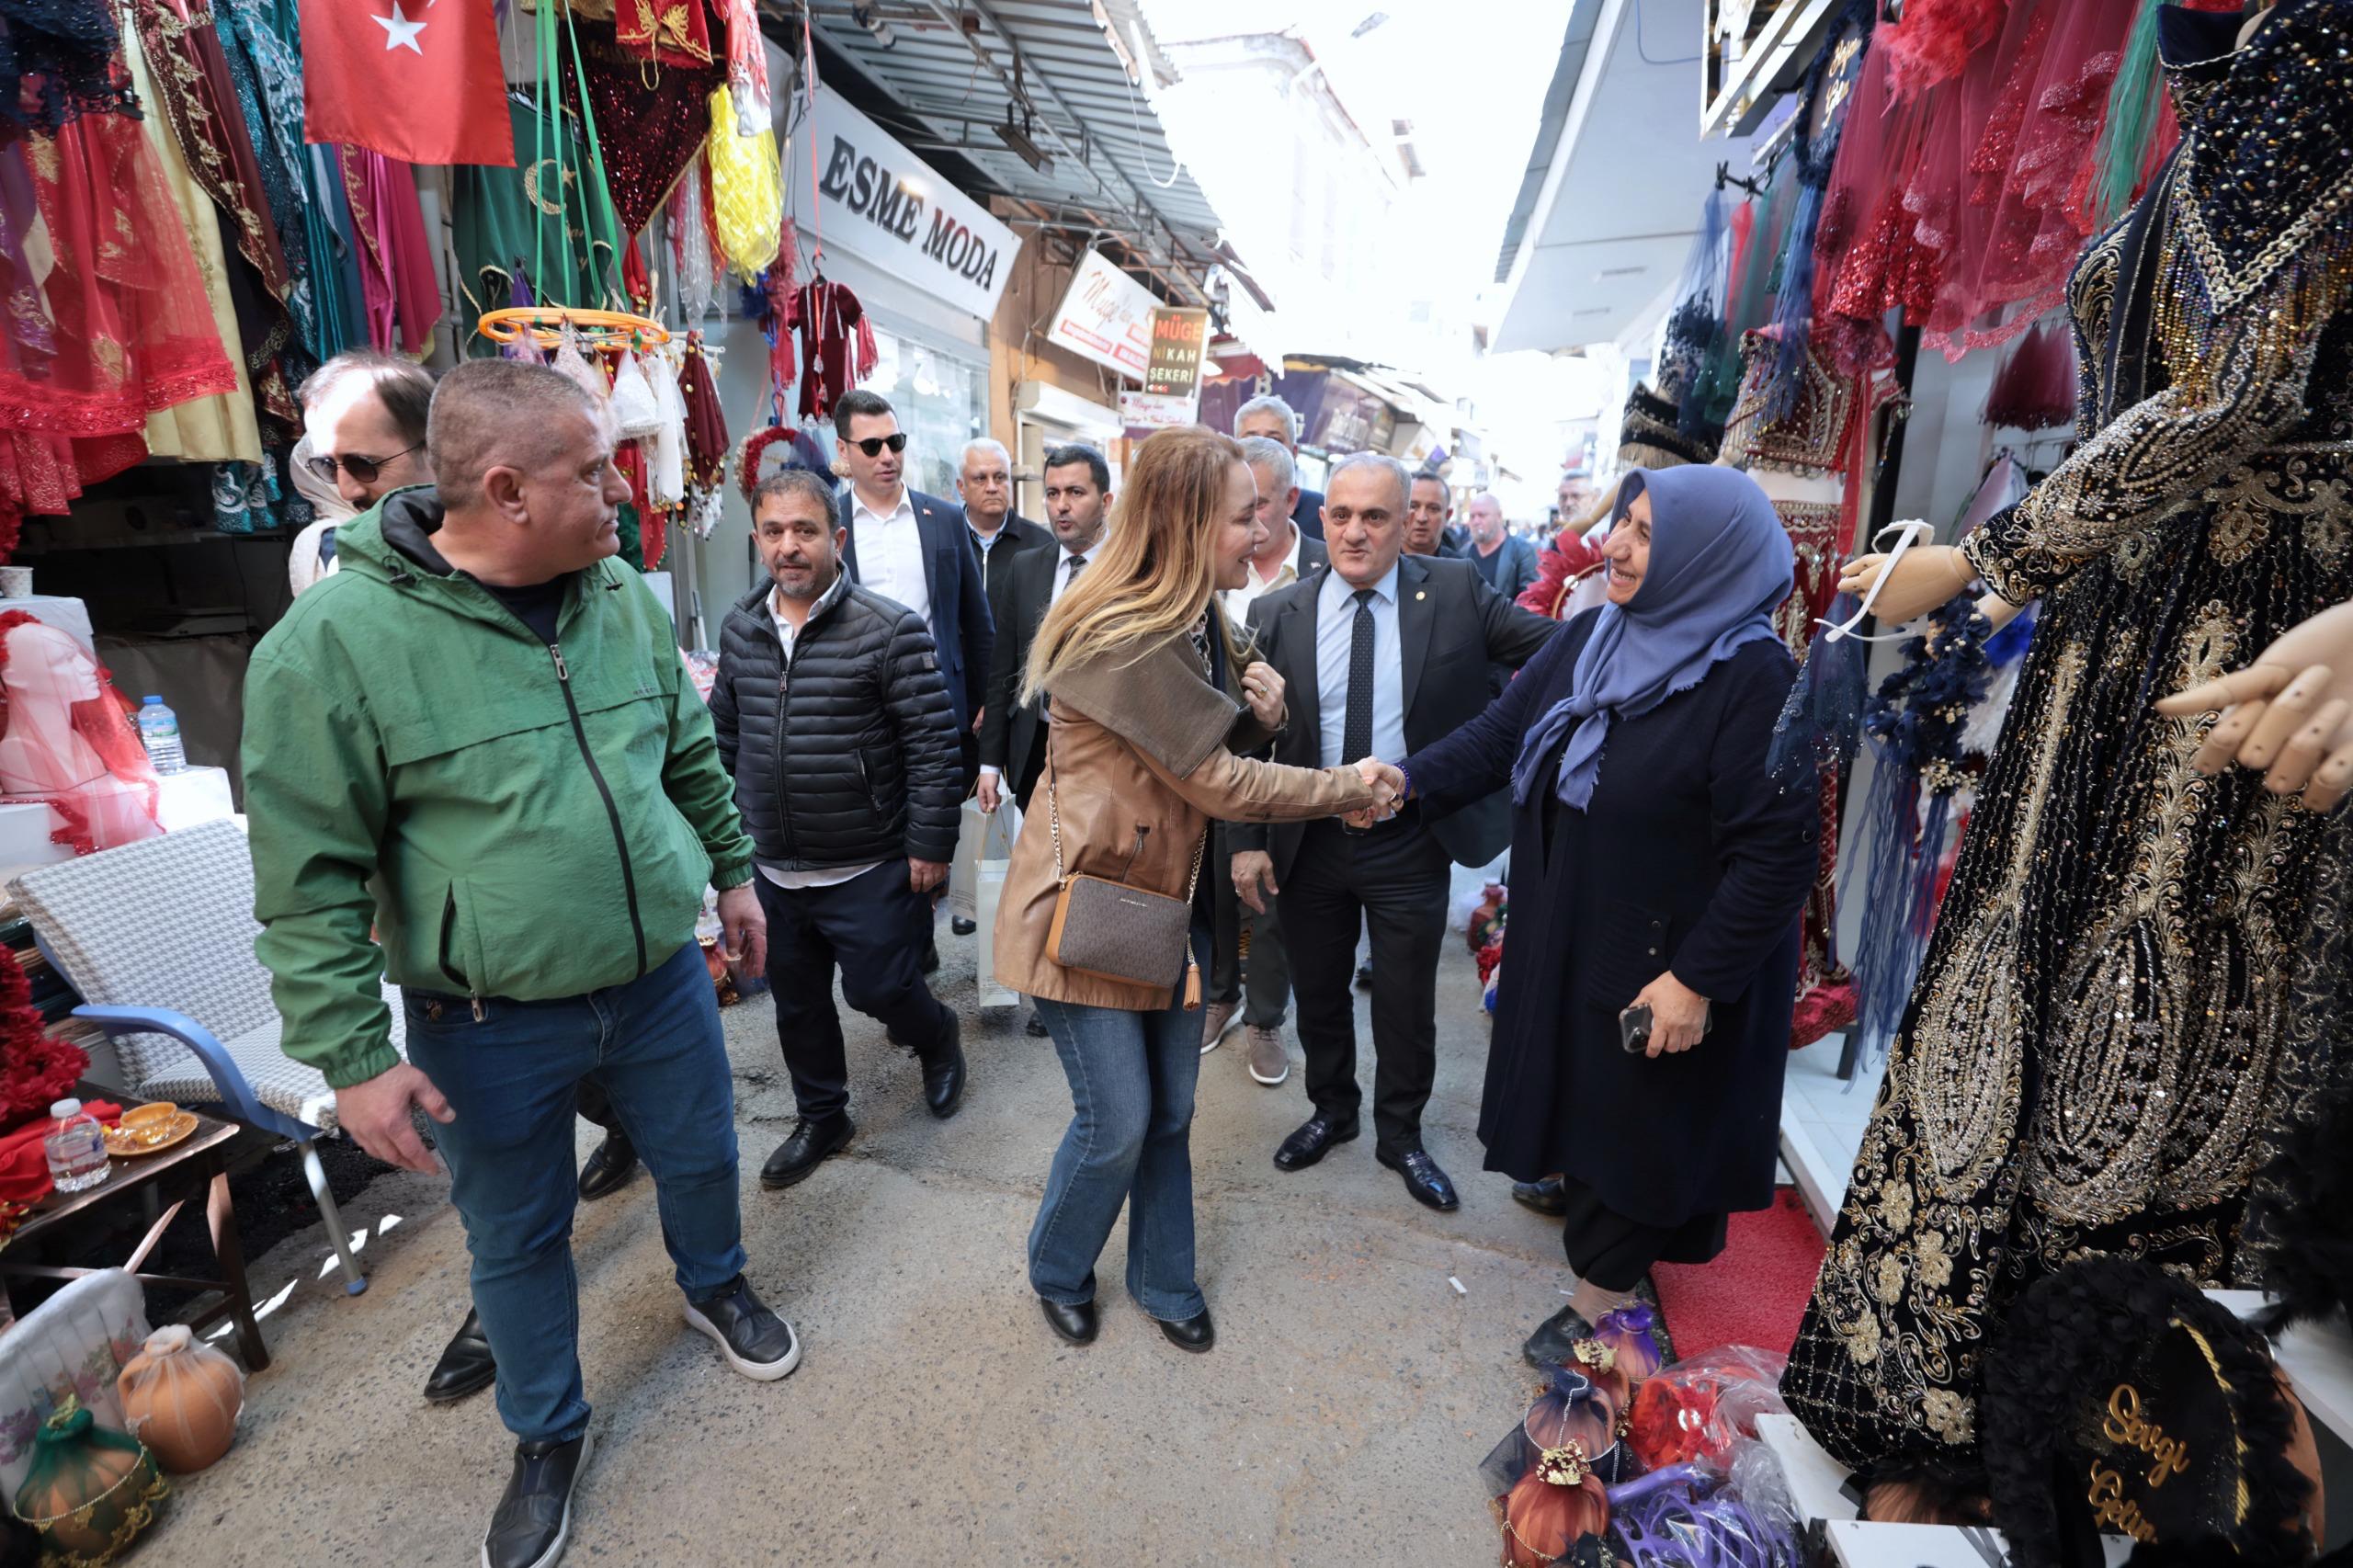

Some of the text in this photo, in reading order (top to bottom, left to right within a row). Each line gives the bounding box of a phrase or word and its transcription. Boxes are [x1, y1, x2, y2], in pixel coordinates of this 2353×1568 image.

[818, 134, 998, 291] ESME MODA
[1154, 313, 1204, 342] MÜGE
[1152, 345, 1198, 363] NİKAH
[1148, 367, 1195, 384] ŞEKERİ
